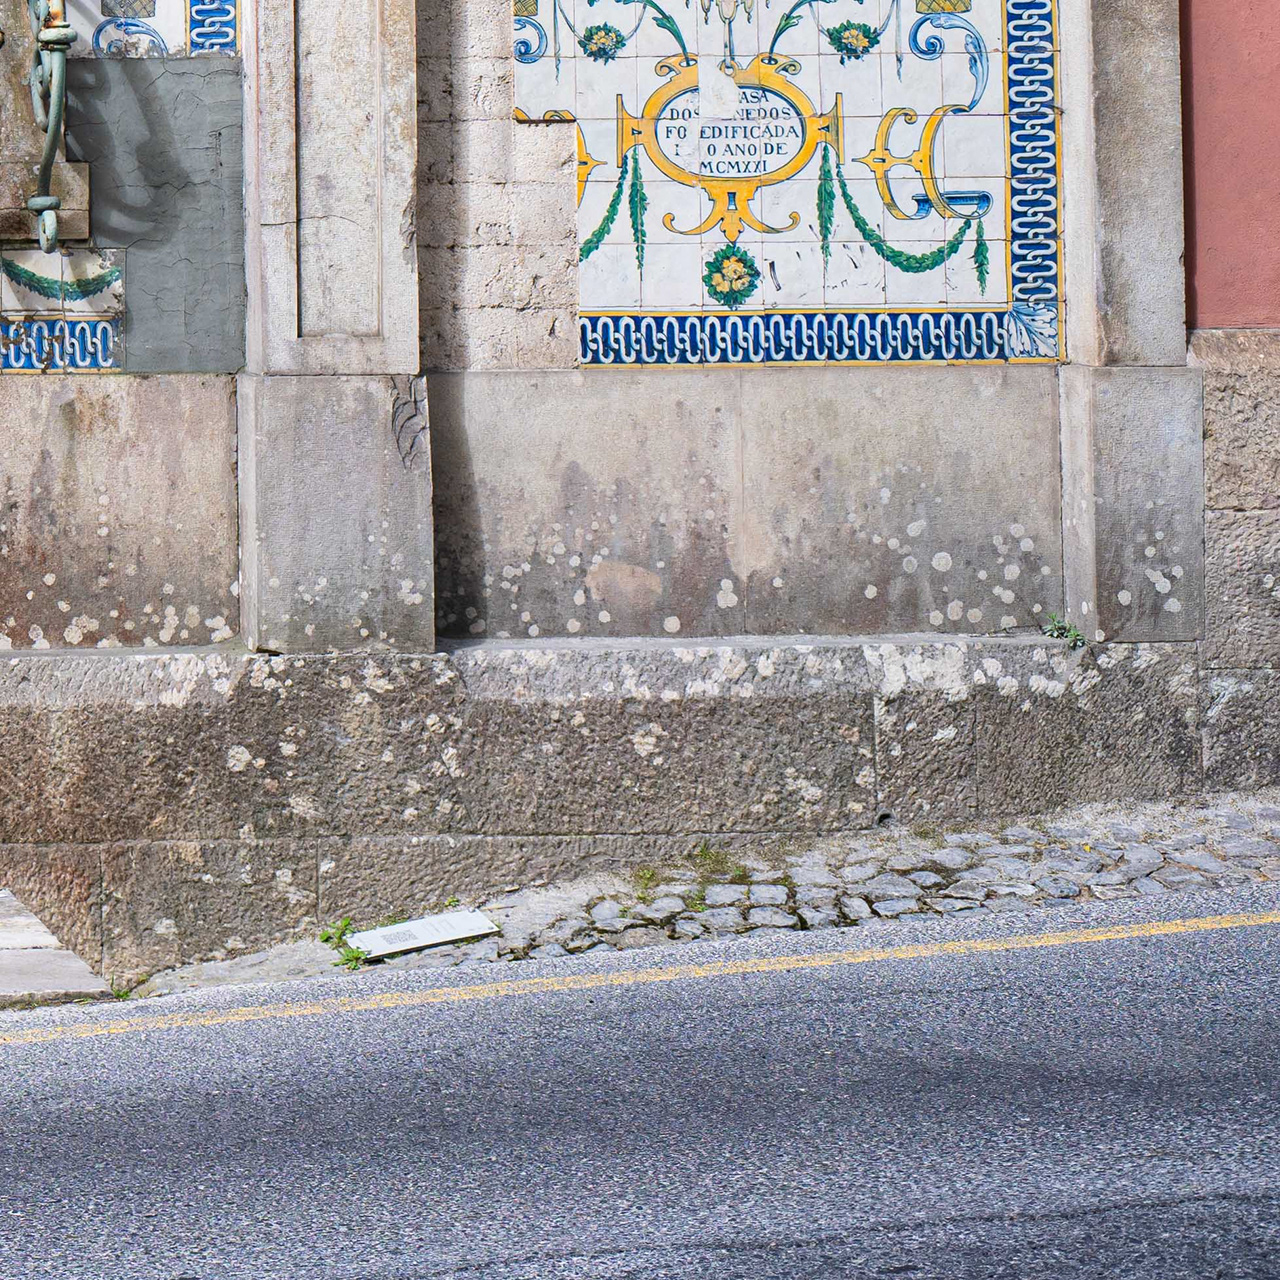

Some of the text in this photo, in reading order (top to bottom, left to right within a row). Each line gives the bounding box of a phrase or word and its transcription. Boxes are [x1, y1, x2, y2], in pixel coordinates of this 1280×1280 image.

[738, 90, 770, 104] ASA
[734, 106, 792, 121] NEDOS
[699, 124, 800, 140] EDIFICADA
[722, 142, 757, 157] ANO
[763, 142, 789, 156] DE
[699, 159, 768, 174] MCMXXI
